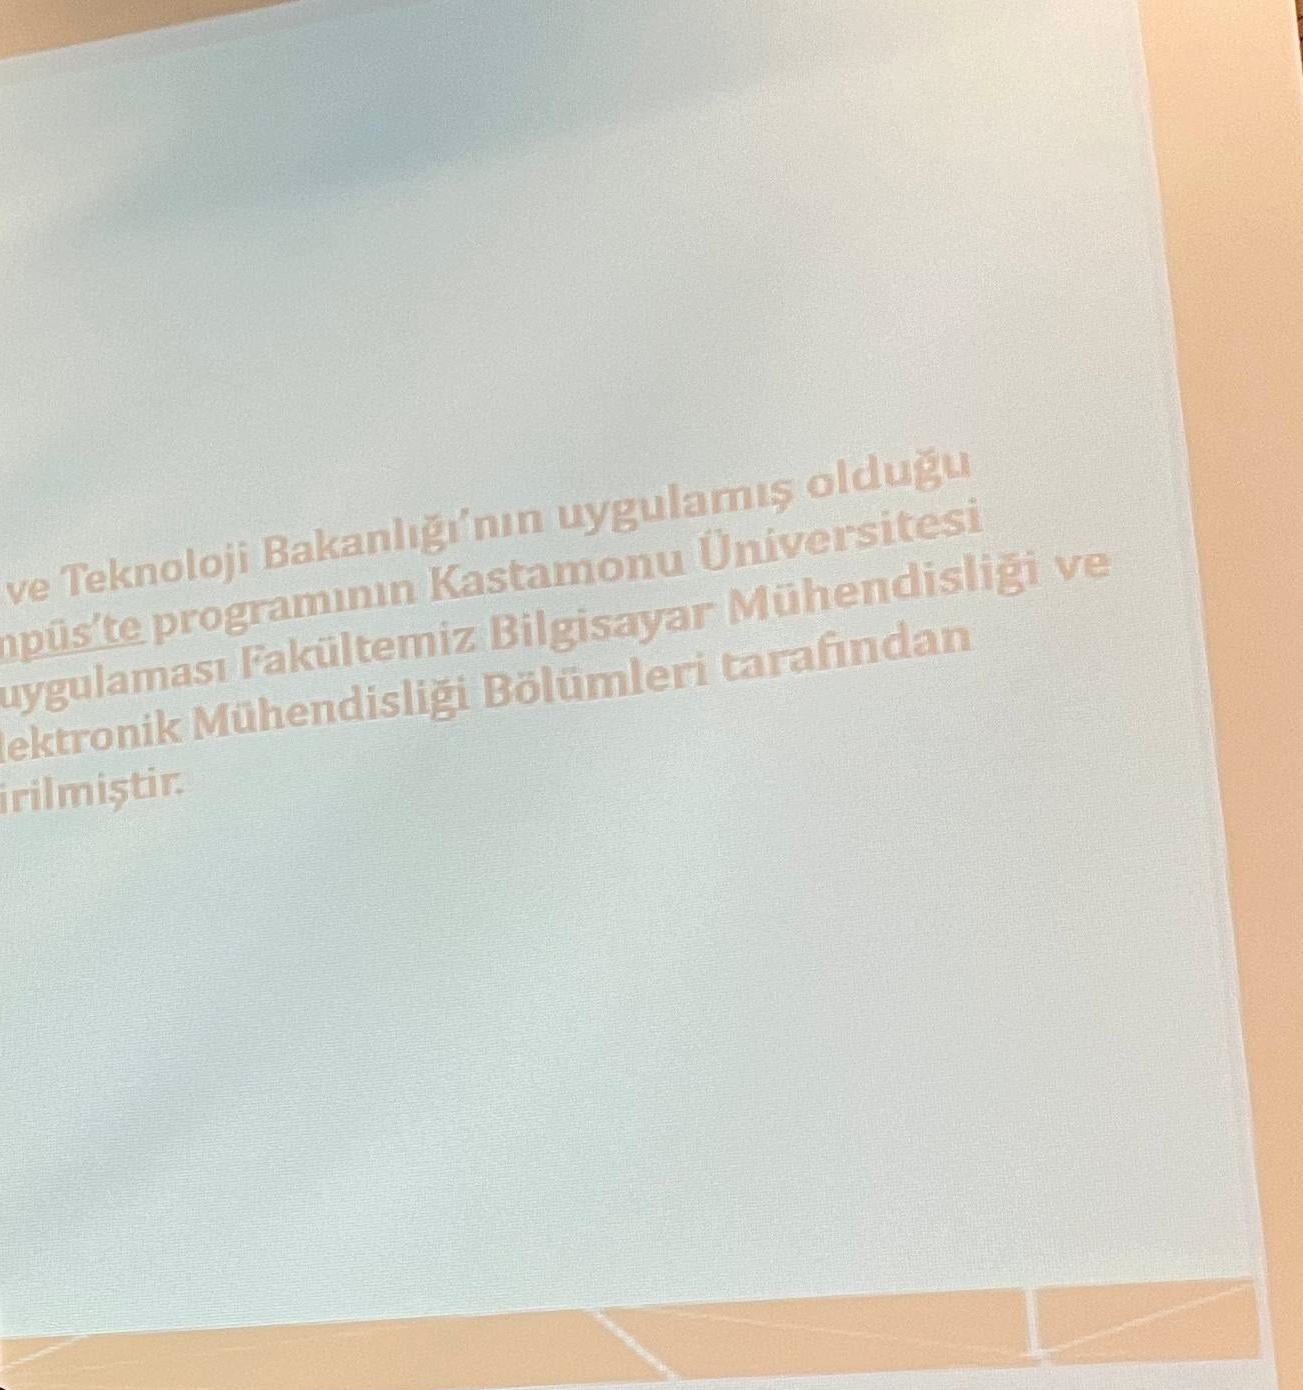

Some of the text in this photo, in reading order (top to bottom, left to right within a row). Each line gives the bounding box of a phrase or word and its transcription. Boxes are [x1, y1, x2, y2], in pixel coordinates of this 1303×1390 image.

[7, 577, 50, 605] ve
[61, 542, 249, 598] Teknoloji
[558, 476, 793, 538] uygulamış
[806, 447, 971, 500] olduğu
[152, 579, 415, 643] programının
[430, 548, 684, 599] Kastamonu
[699, 498, 983, 573] Üniversitesi
[192, 674, 470, 742] Mühendisliği
[484, 652, 708, 709] Bölümleri
[721, 620, 974, 683] tarafından
[241, 621, 476, 680] Fakültemiz
[490, 599, 714, 653] Bilgisayar
[728, 551, 1039, 626] Mühendisliği
[1055, 551, 1111, 580] ve
